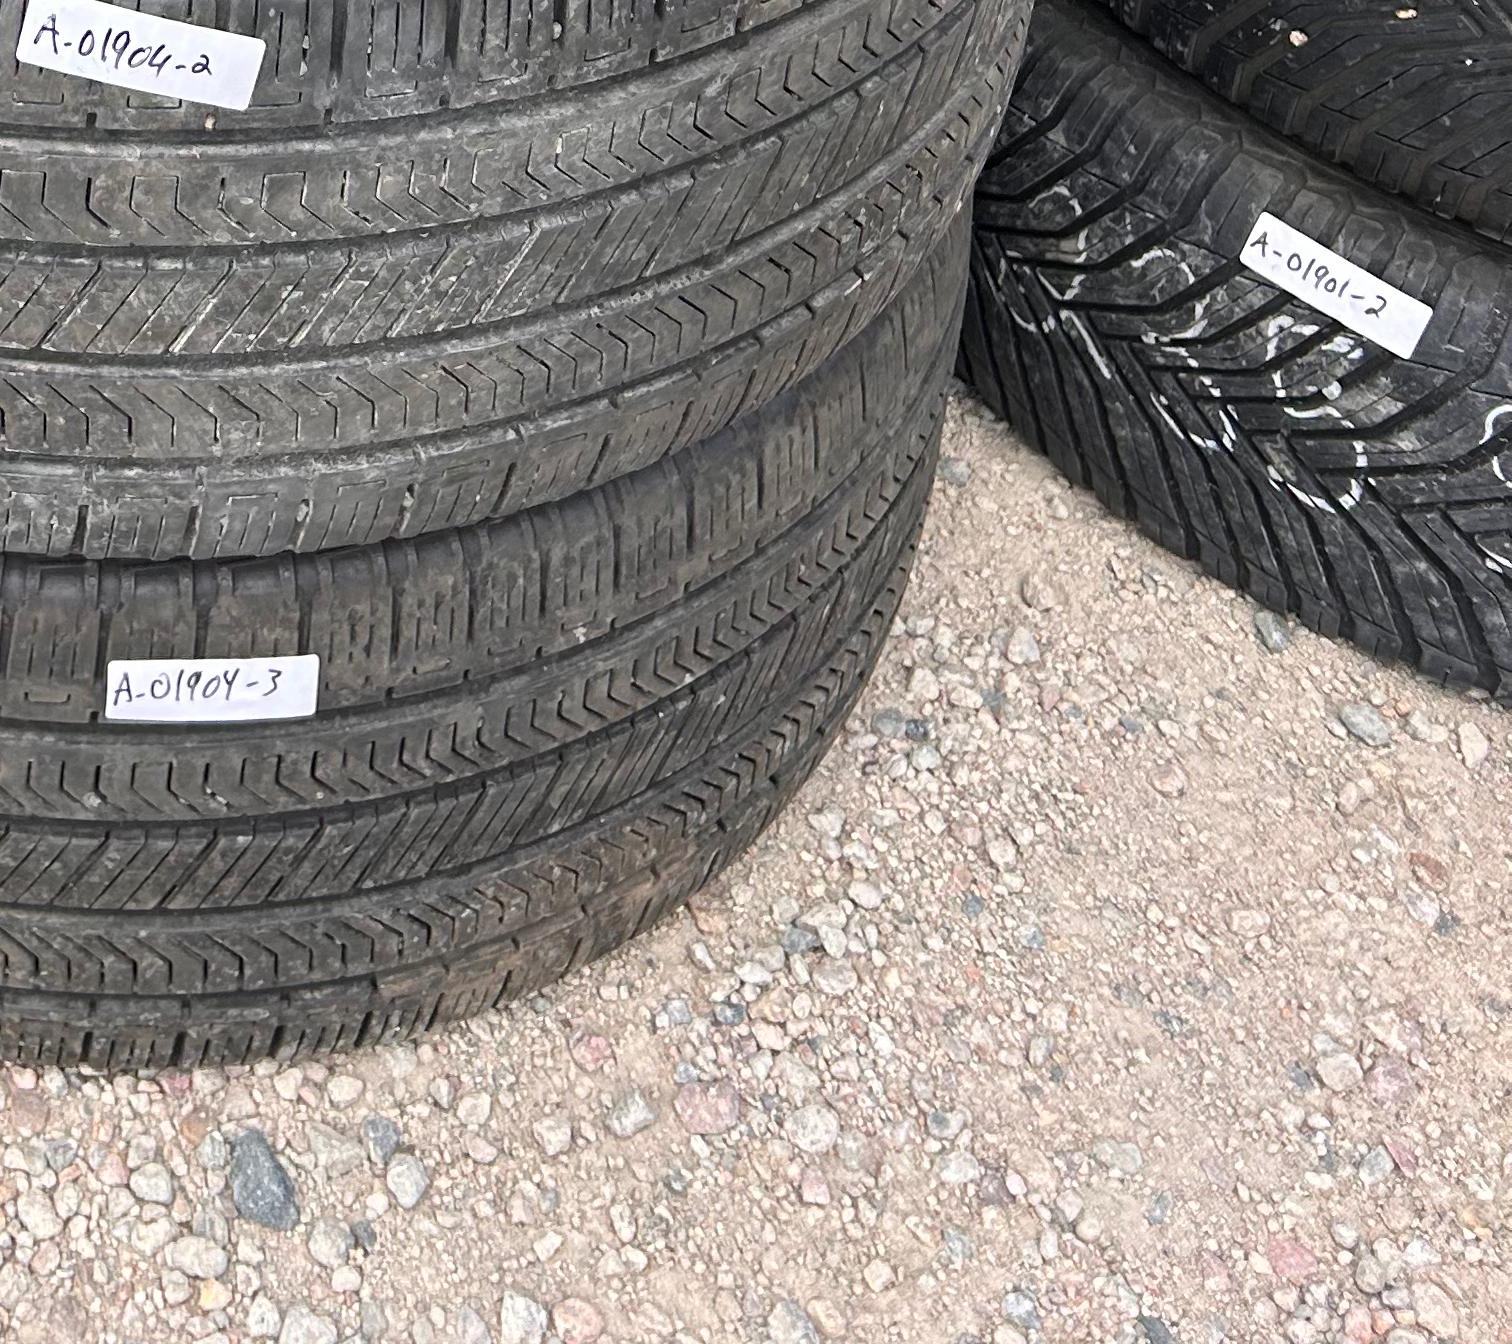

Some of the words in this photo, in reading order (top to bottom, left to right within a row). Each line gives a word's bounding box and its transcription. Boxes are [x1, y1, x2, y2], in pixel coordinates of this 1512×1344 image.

[32, 12, 213, 78] A-01904-2
[1248, 229, 1389, 320] A-01901-2
[112, 667, 283, 707] A-01904-3
